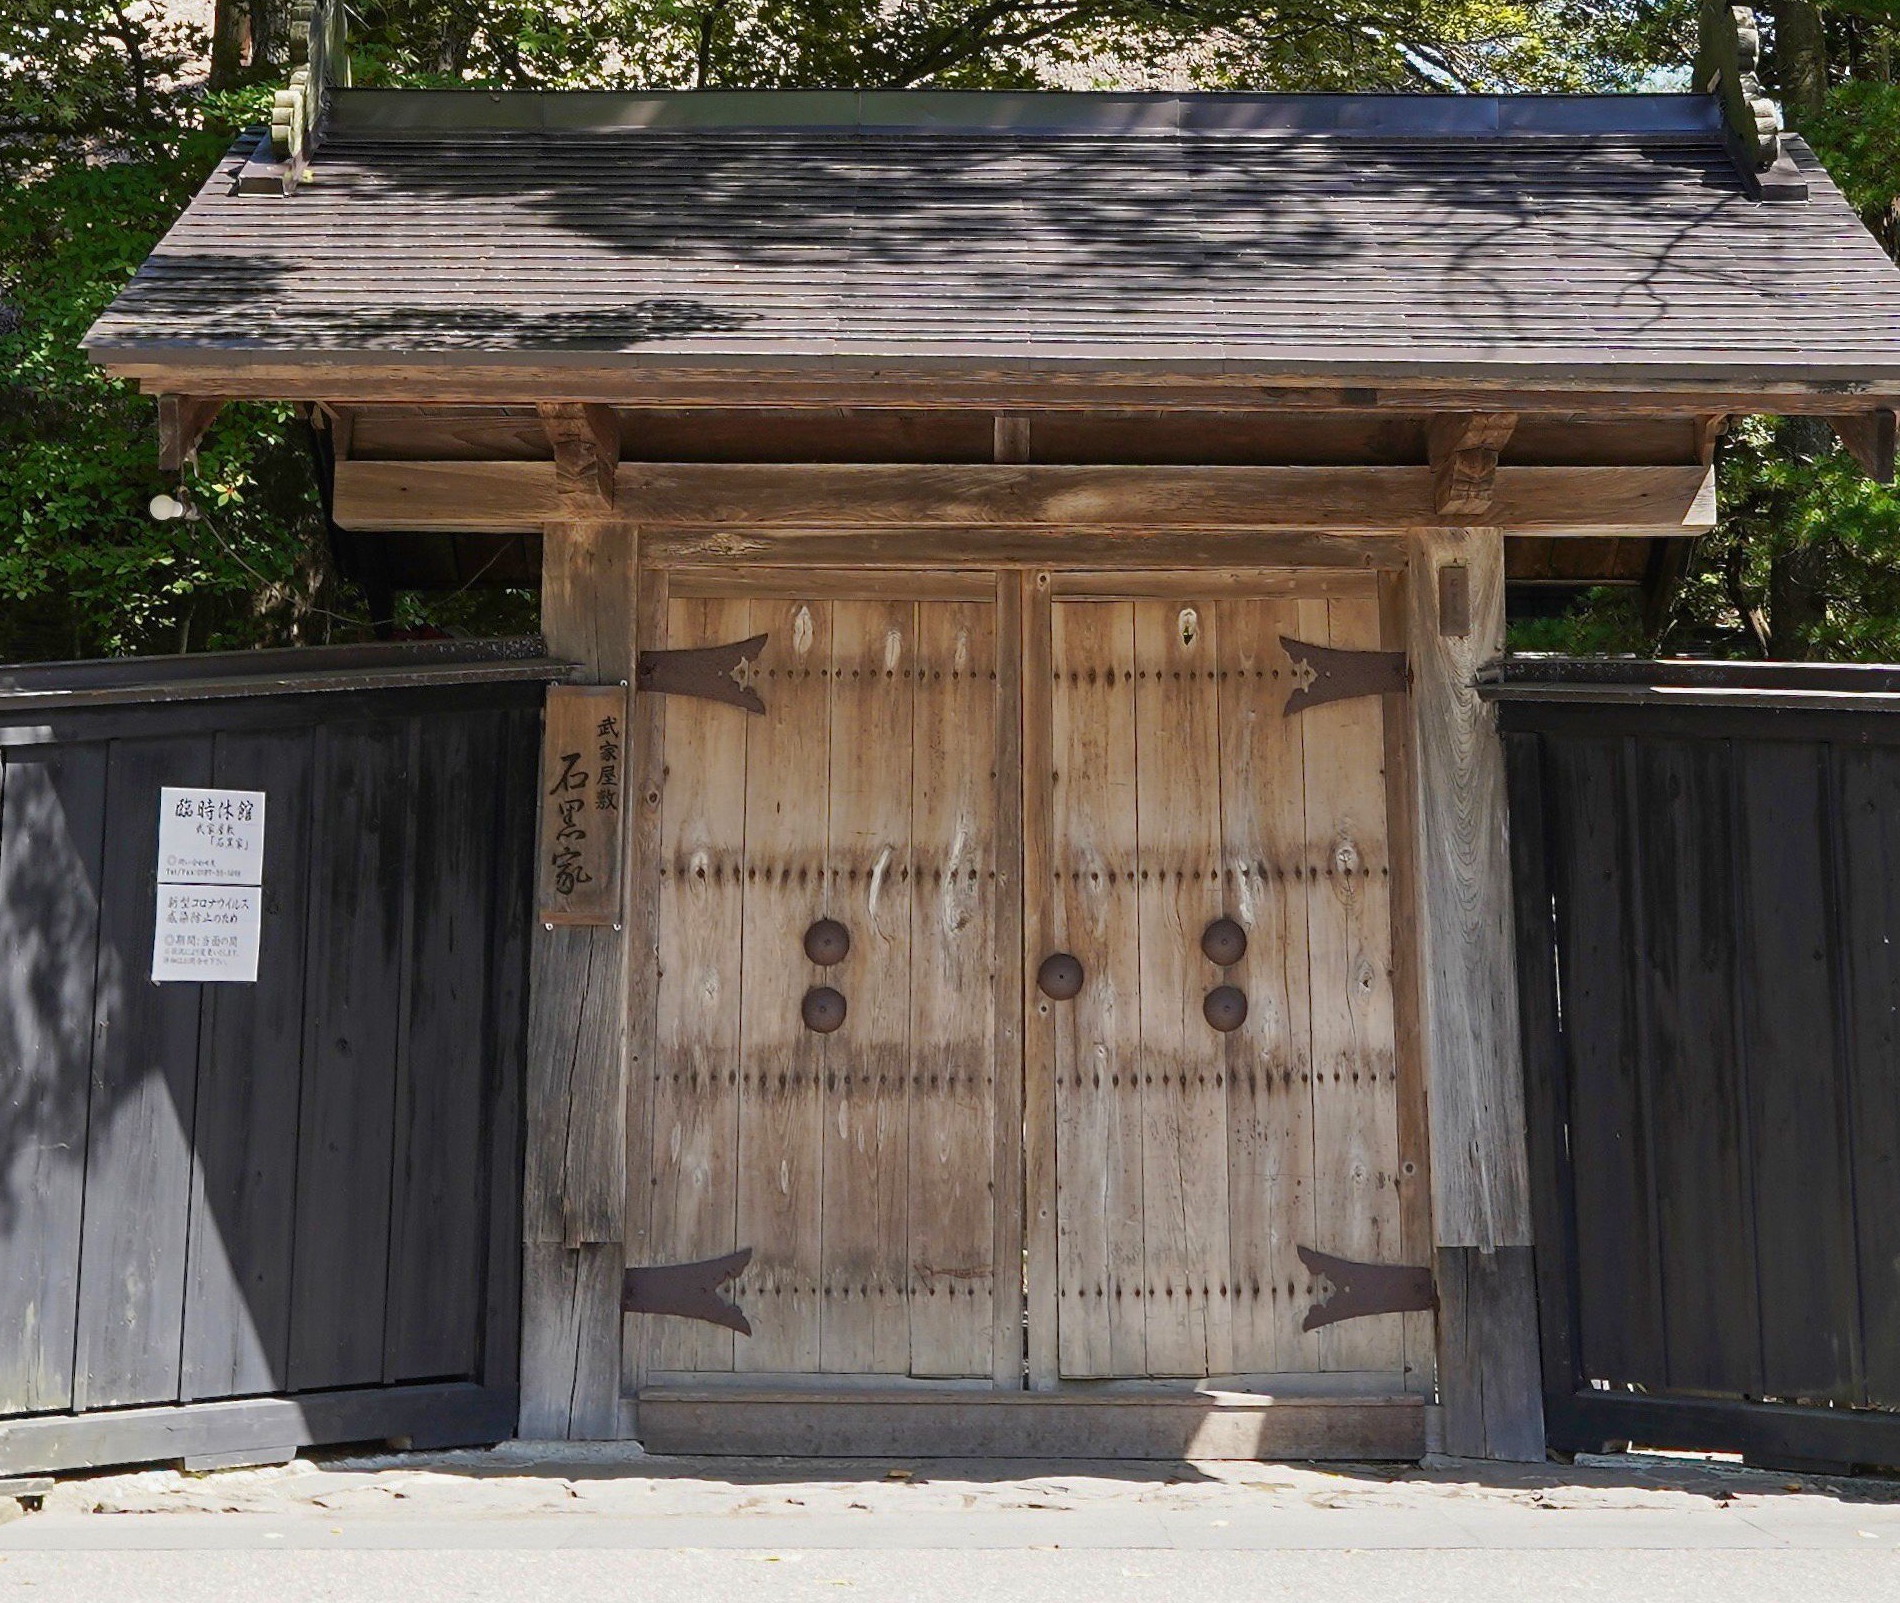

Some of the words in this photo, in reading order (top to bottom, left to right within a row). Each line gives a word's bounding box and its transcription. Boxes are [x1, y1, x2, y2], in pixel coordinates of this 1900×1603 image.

[175, 797, 254, 822] 臨時休館
[595, 715, 620, 811] 武家屋敷
[549, 752, 592, 895] 石黒家
